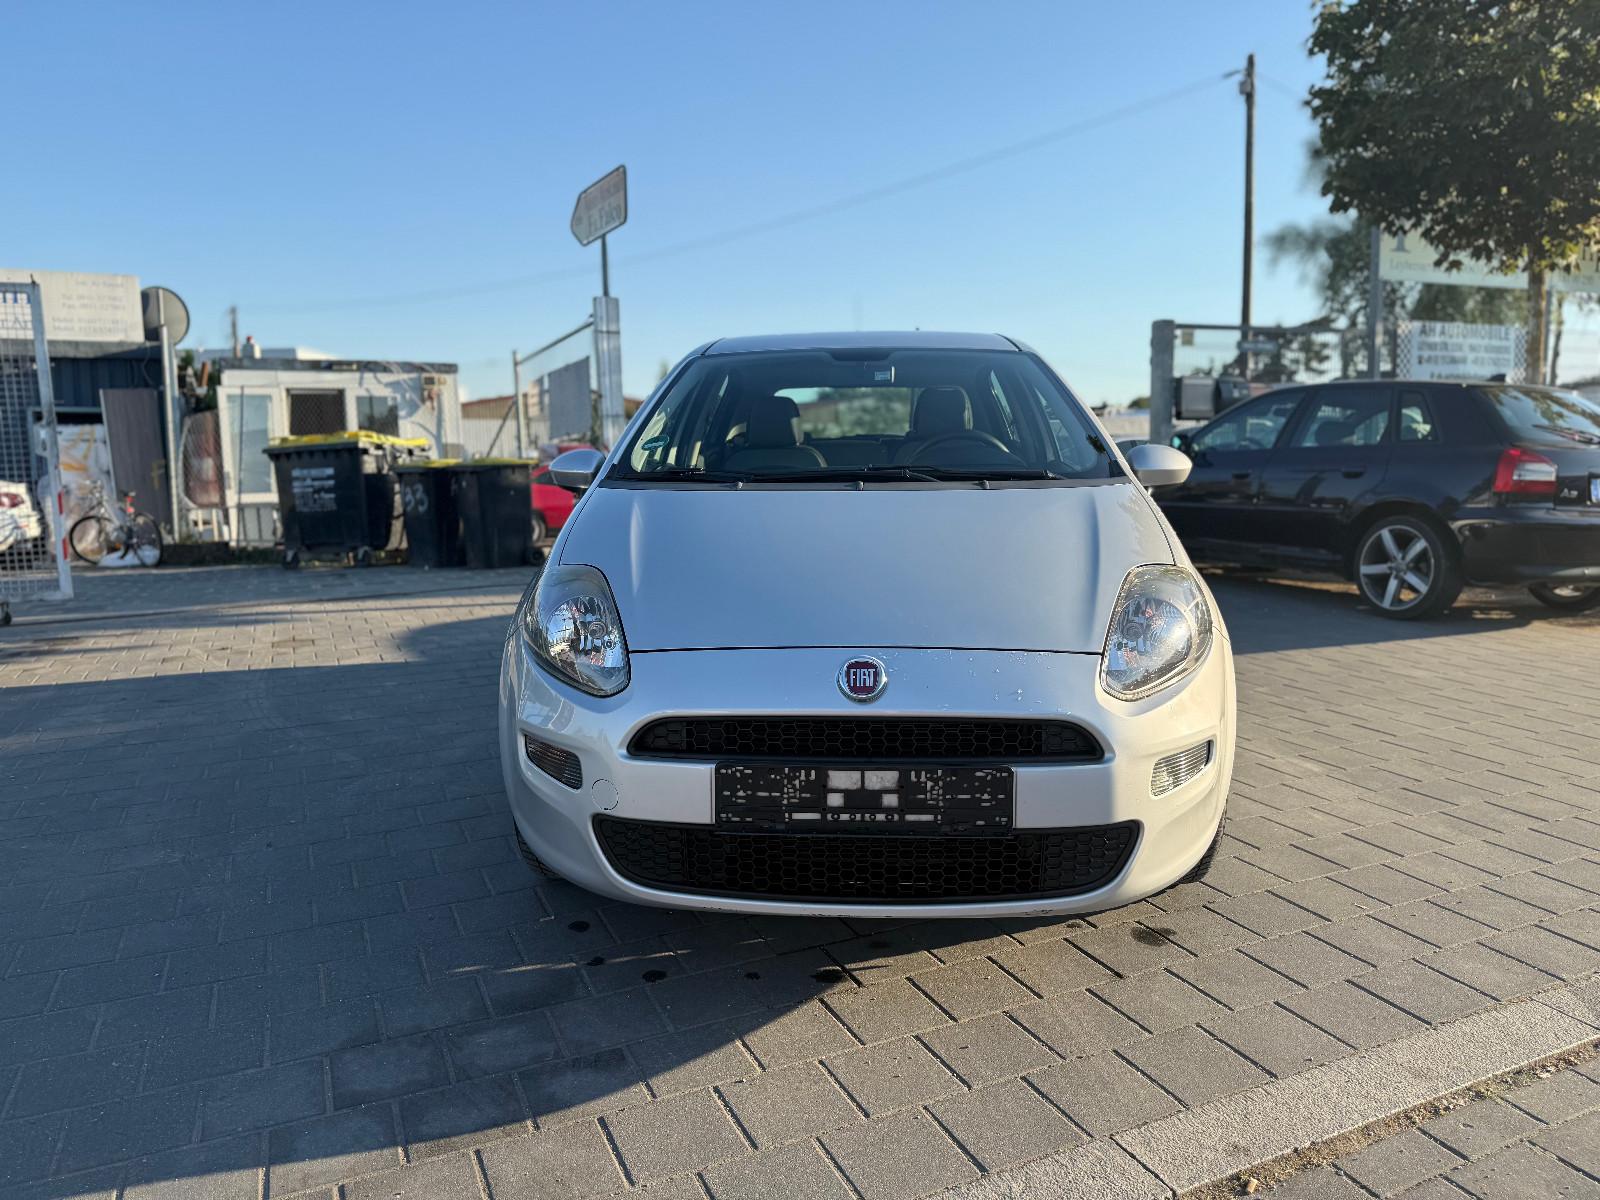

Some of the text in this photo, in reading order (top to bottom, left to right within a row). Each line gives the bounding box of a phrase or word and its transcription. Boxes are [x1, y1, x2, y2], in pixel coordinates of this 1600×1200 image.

[1419, 323, 1511, 341] AH AUTOMOBILE
[850, 668, 876, 687] FIAT
